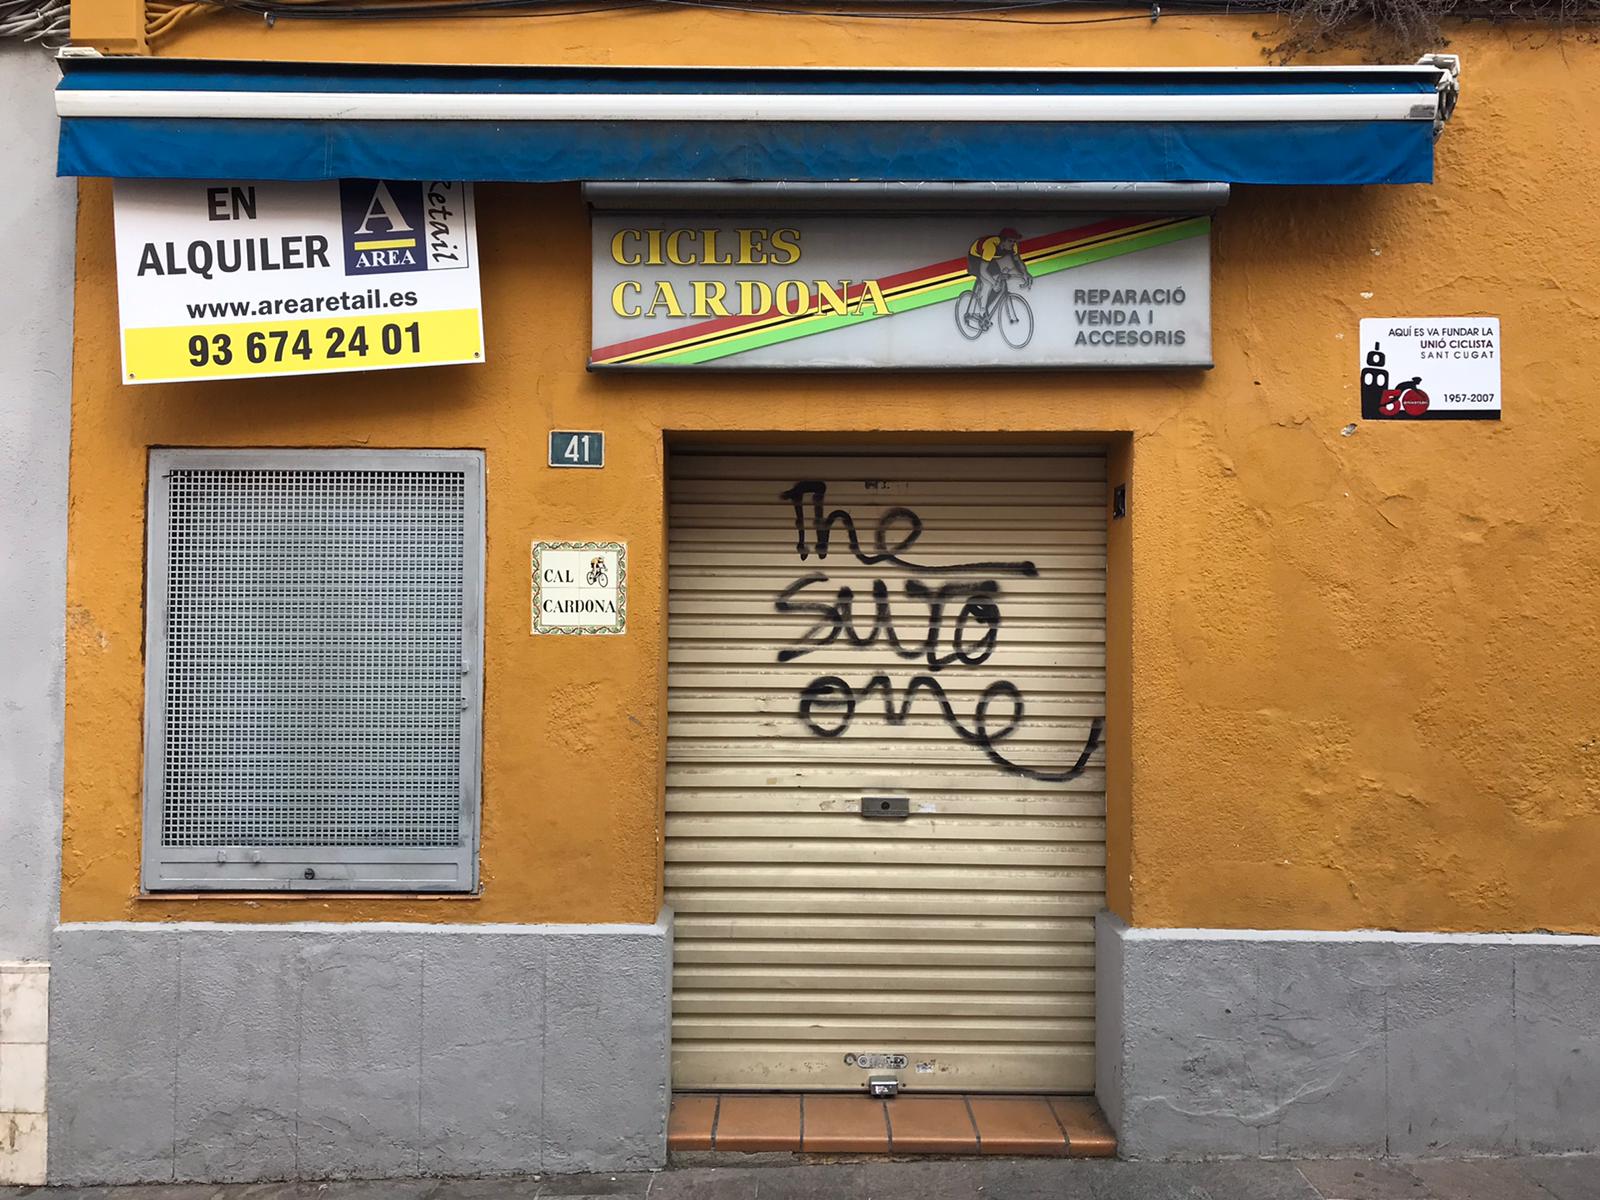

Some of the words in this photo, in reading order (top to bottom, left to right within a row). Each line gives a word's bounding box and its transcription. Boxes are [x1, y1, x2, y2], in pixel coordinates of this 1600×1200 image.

[207, 186, 257, 221] EN
[611, 228, 802, 266] CICLES
[137, 234, 331, 280] ALQUILER
[355, 249, 417, 269] AREA
[186, 289, 418, 319] www.arearetail.es
[611, 279, 894, 318] CARDONA
[1074, 286, 1186, 305] REPARACIÓ
[1075, 310, 1141, 325] VENDA
[1075, 330, 1186, 346] ACCESORIS
[1414, 328, 1425, 337] ES
[1427, 328, 1440, 337] VA
[1442, 328, 1479, 337] FUNDAR
[1482, 328, 1494, 337] LA
[188, 333, 232, 367] 93
[246, 329, 313, 363] 674
[326, 325, 369, 358] 24
[382, 322, 422, 354] 01
[1420, 338, 1447, 349] UNIÓ
[1449, 340, 1494, 349] CICLISTA
[1421, 351, 1449, 359] SANT
[1453, 351, 1494, 359] CUGAT
[1444, 394, 1495, 403] 1957-2007
[564, 435, 591, 463] 41
[544, 569, 575, 583] CAL
[543, 599, 617, 614] CARDONA
